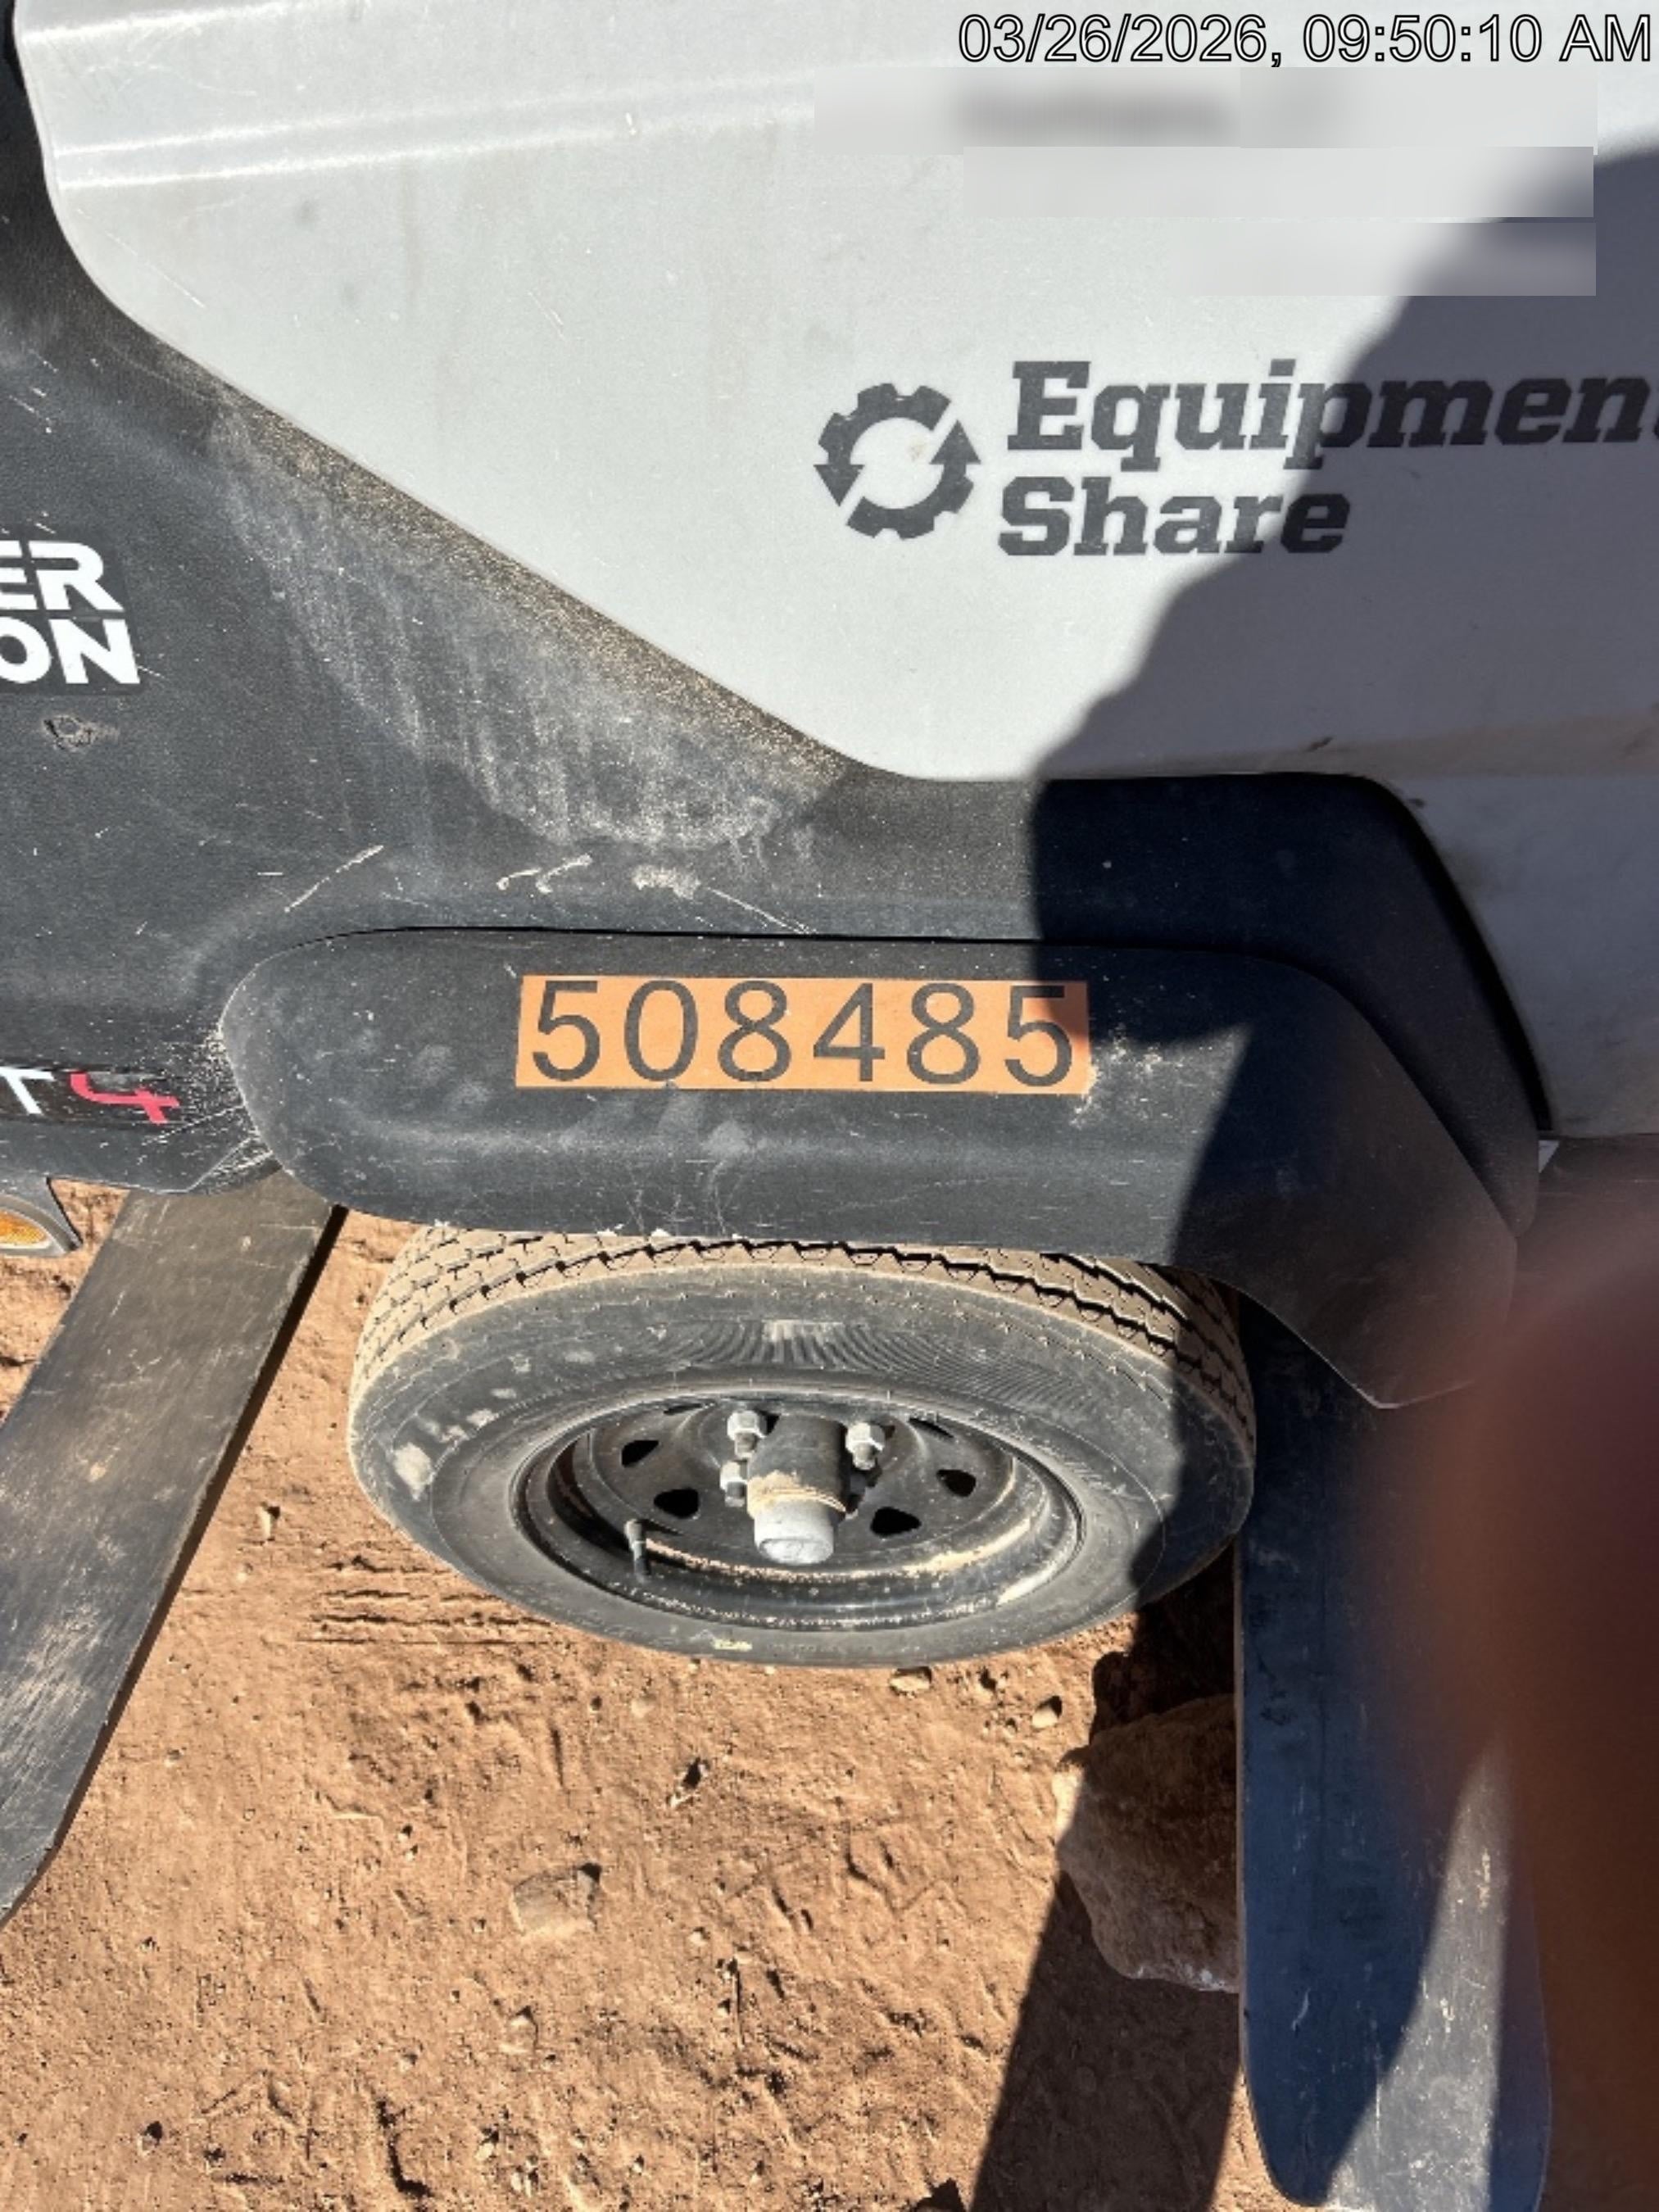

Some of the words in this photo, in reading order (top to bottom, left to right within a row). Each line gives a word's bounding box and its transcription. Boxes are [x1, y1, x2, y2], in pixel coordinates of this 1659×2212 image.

[1007, 359, 1659, 472] Equipmen
[998, 475, 1351, 556] Share
[531, 979, 1073, 1088] 508485
